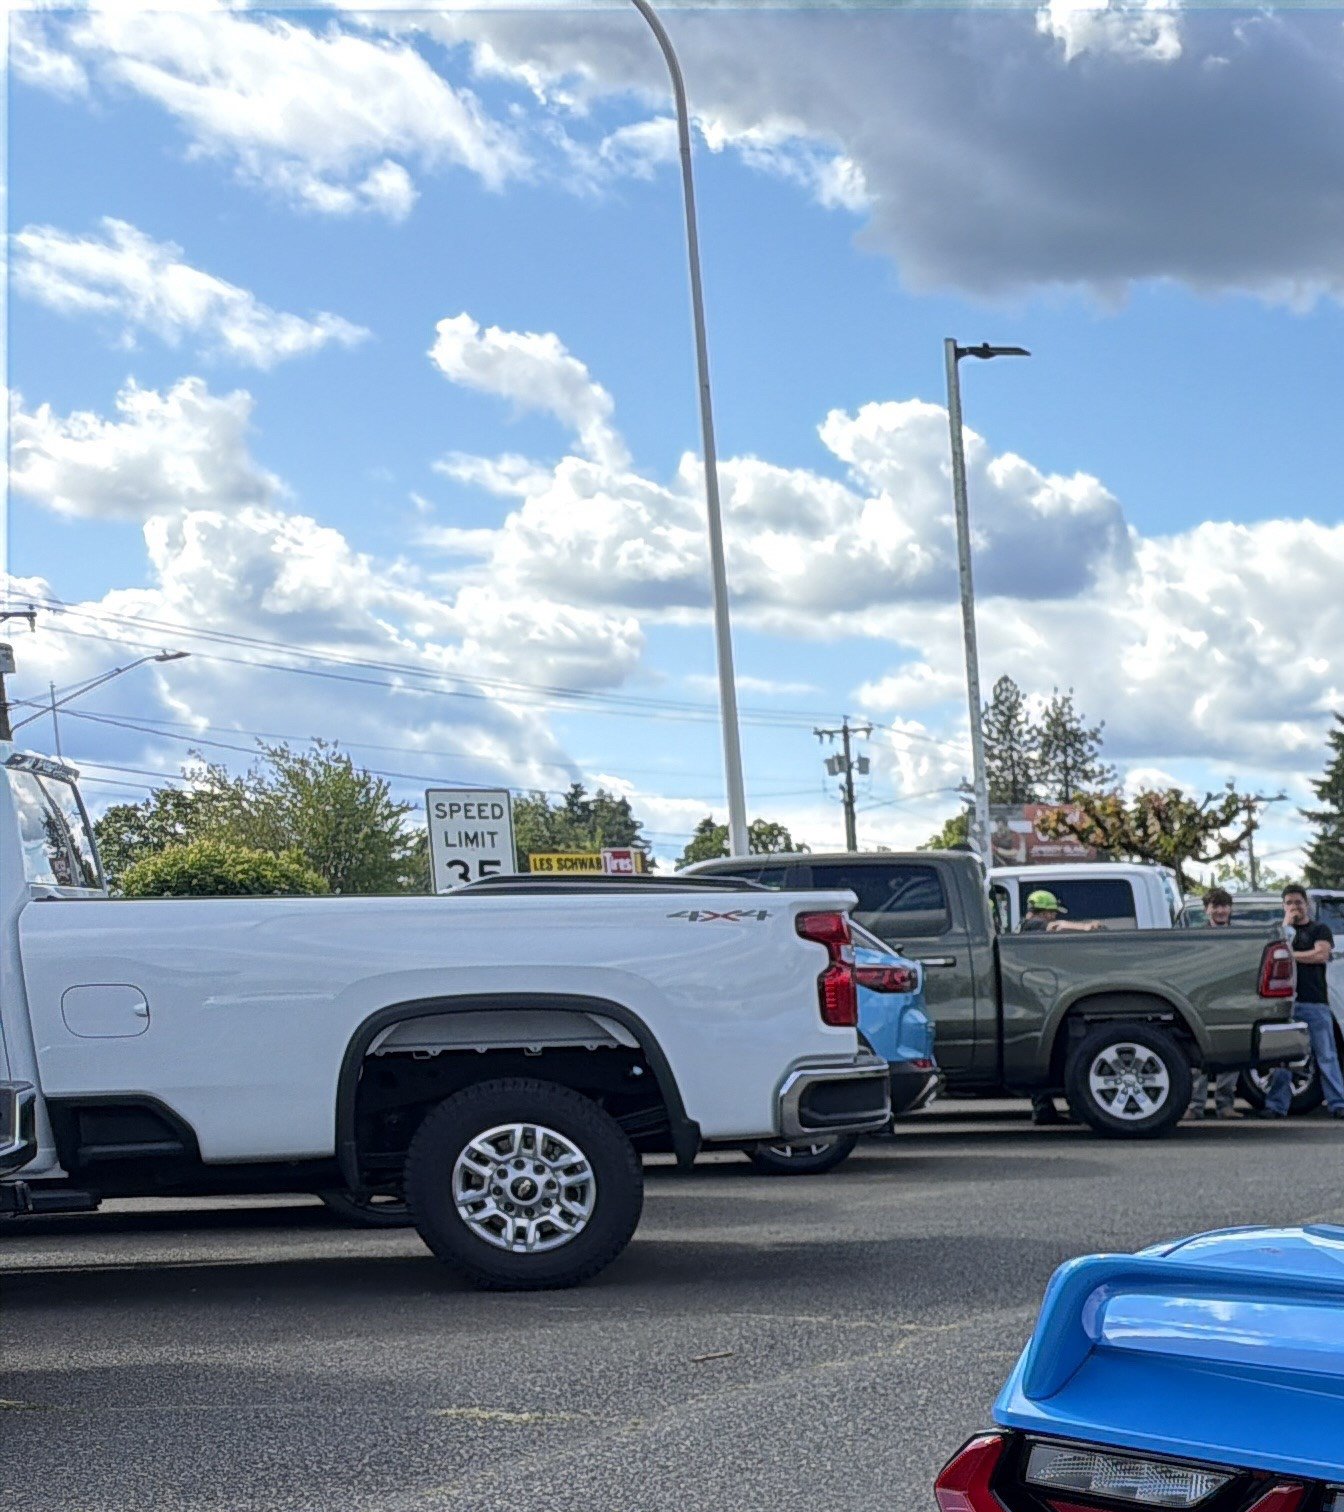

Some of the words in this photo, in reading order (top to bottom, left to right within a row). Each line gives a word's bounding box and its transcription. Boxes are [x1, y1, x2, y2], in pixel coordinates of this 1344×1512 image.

[435, 803, 504, 820] SPEED
[444, 831, 499, 848] LIMIT
[532, 857, 554, 872] LES
